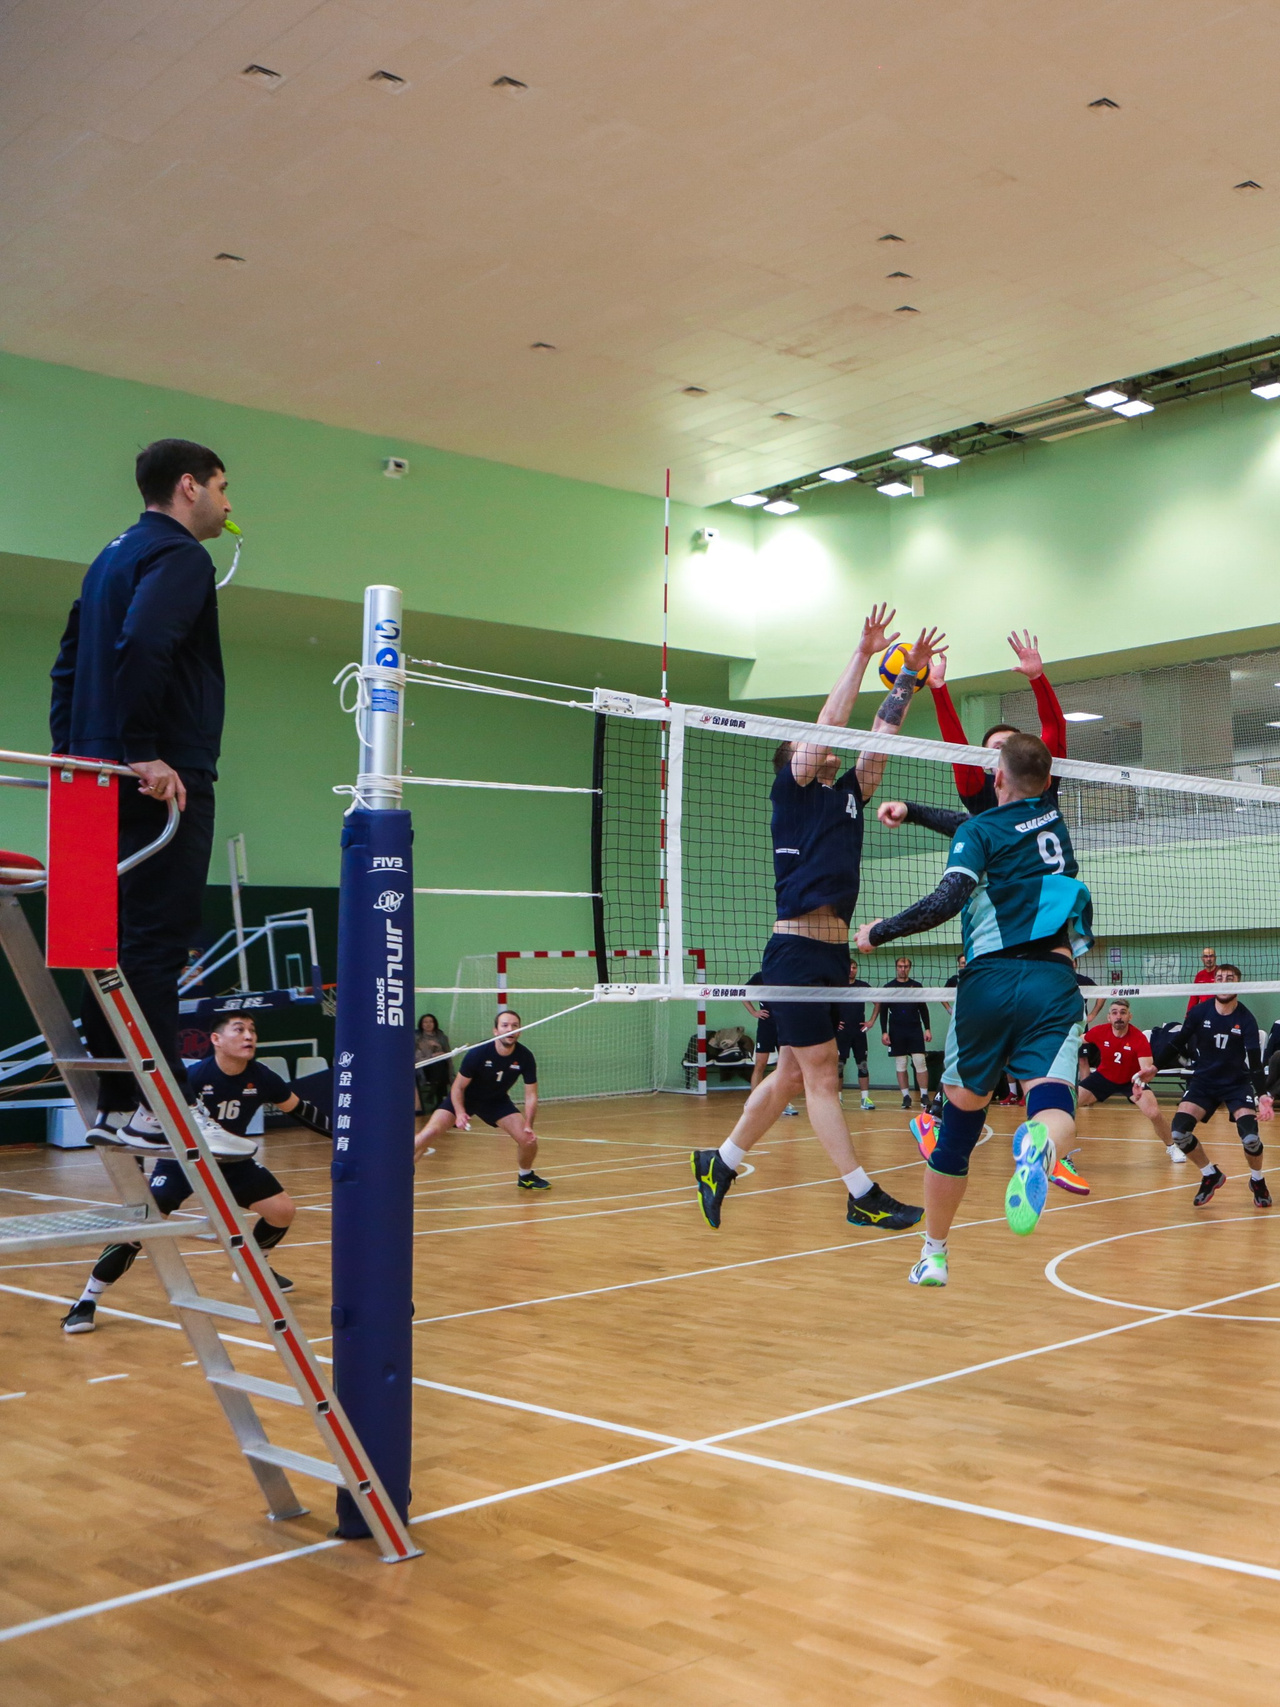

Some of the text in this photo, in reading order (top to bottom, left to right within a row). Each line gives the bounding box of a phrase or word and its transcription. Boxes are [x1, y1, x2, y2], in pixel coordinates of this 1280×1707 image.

[845, 793, 858, 819] 4
[1036, 831, 1066, 875] 9
[376, 977, 386, 1025] SPORTS
[1213, 1033, 1229, 1049] 17
[1113, 1051, 1122, 1064] 2
[496, 1070, 504, 1082] 1
[217, 1099, 241, 1120] 16
[336, 1071, 353, 1152] 金陵体育
[150, 1175, 167, 1187] 16
